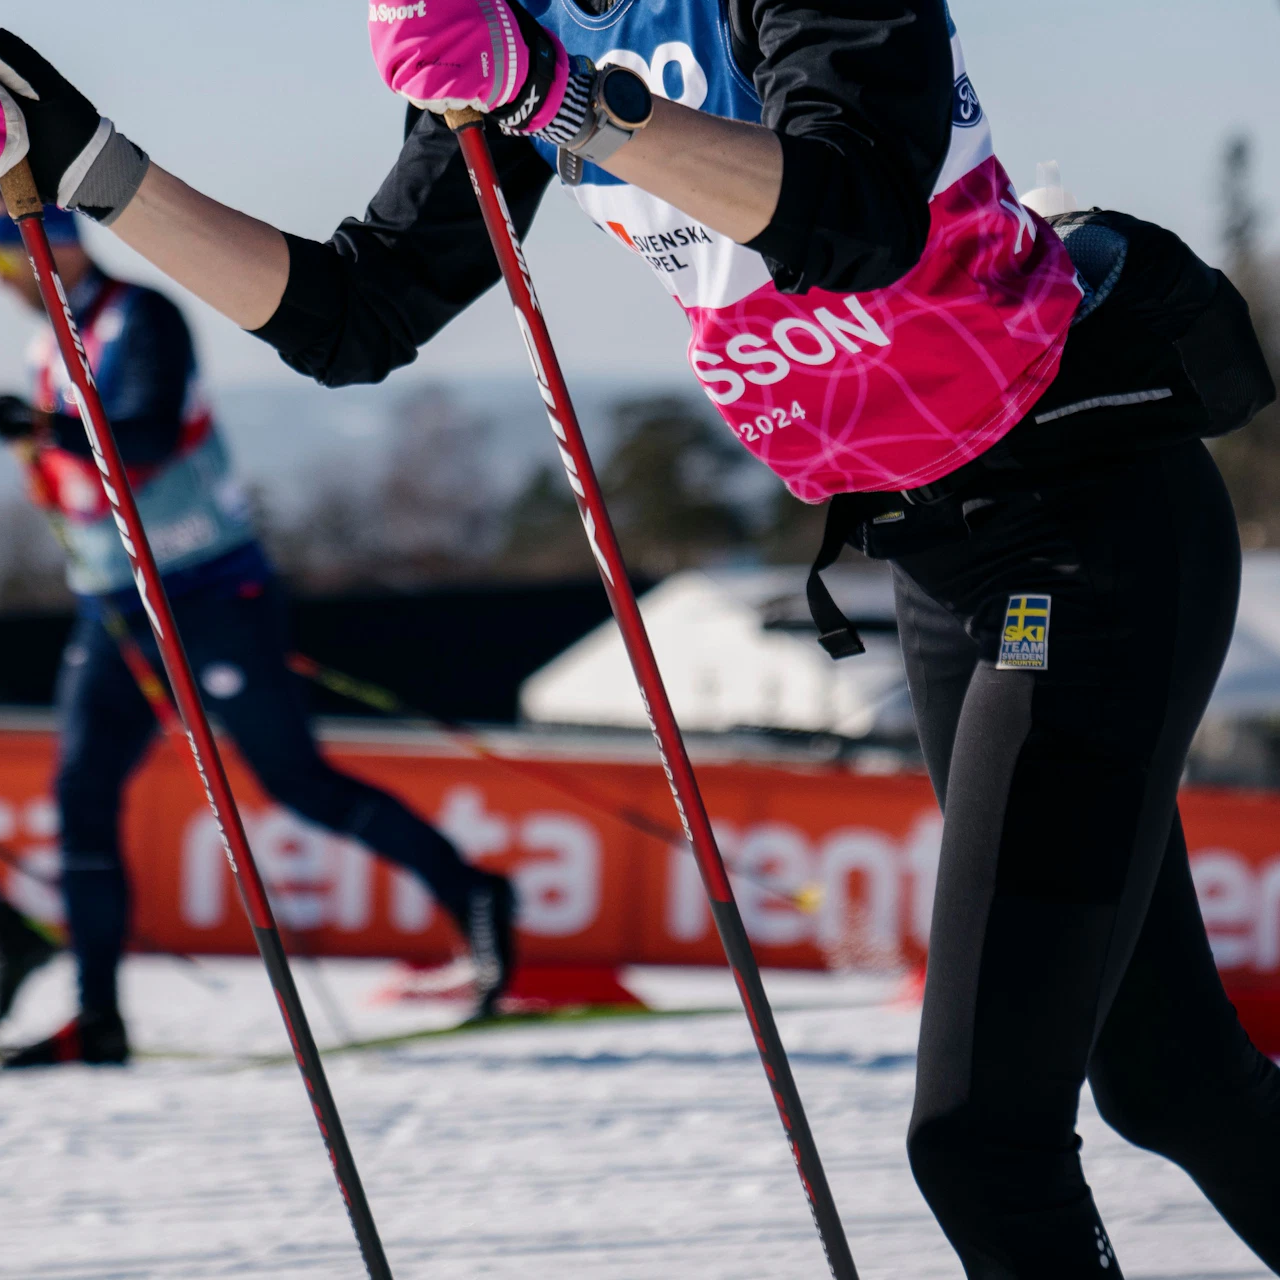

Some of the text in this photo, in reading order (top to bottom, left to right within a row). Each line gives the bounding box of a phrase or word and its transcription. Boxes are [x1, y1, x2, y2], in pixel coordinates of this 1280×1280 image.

[493, 183, 545, 320] SWIX
[632, 225, 713, 253] SVENSKA
[51, 270, 98, 391] SWIX
[691, 294, 892, 406] SSON
[1004, 625, 1046, 642] SKI
[1004, 641, 1044, 654] TEAM
[1001, 652, 1044, 661] SWEDEN
